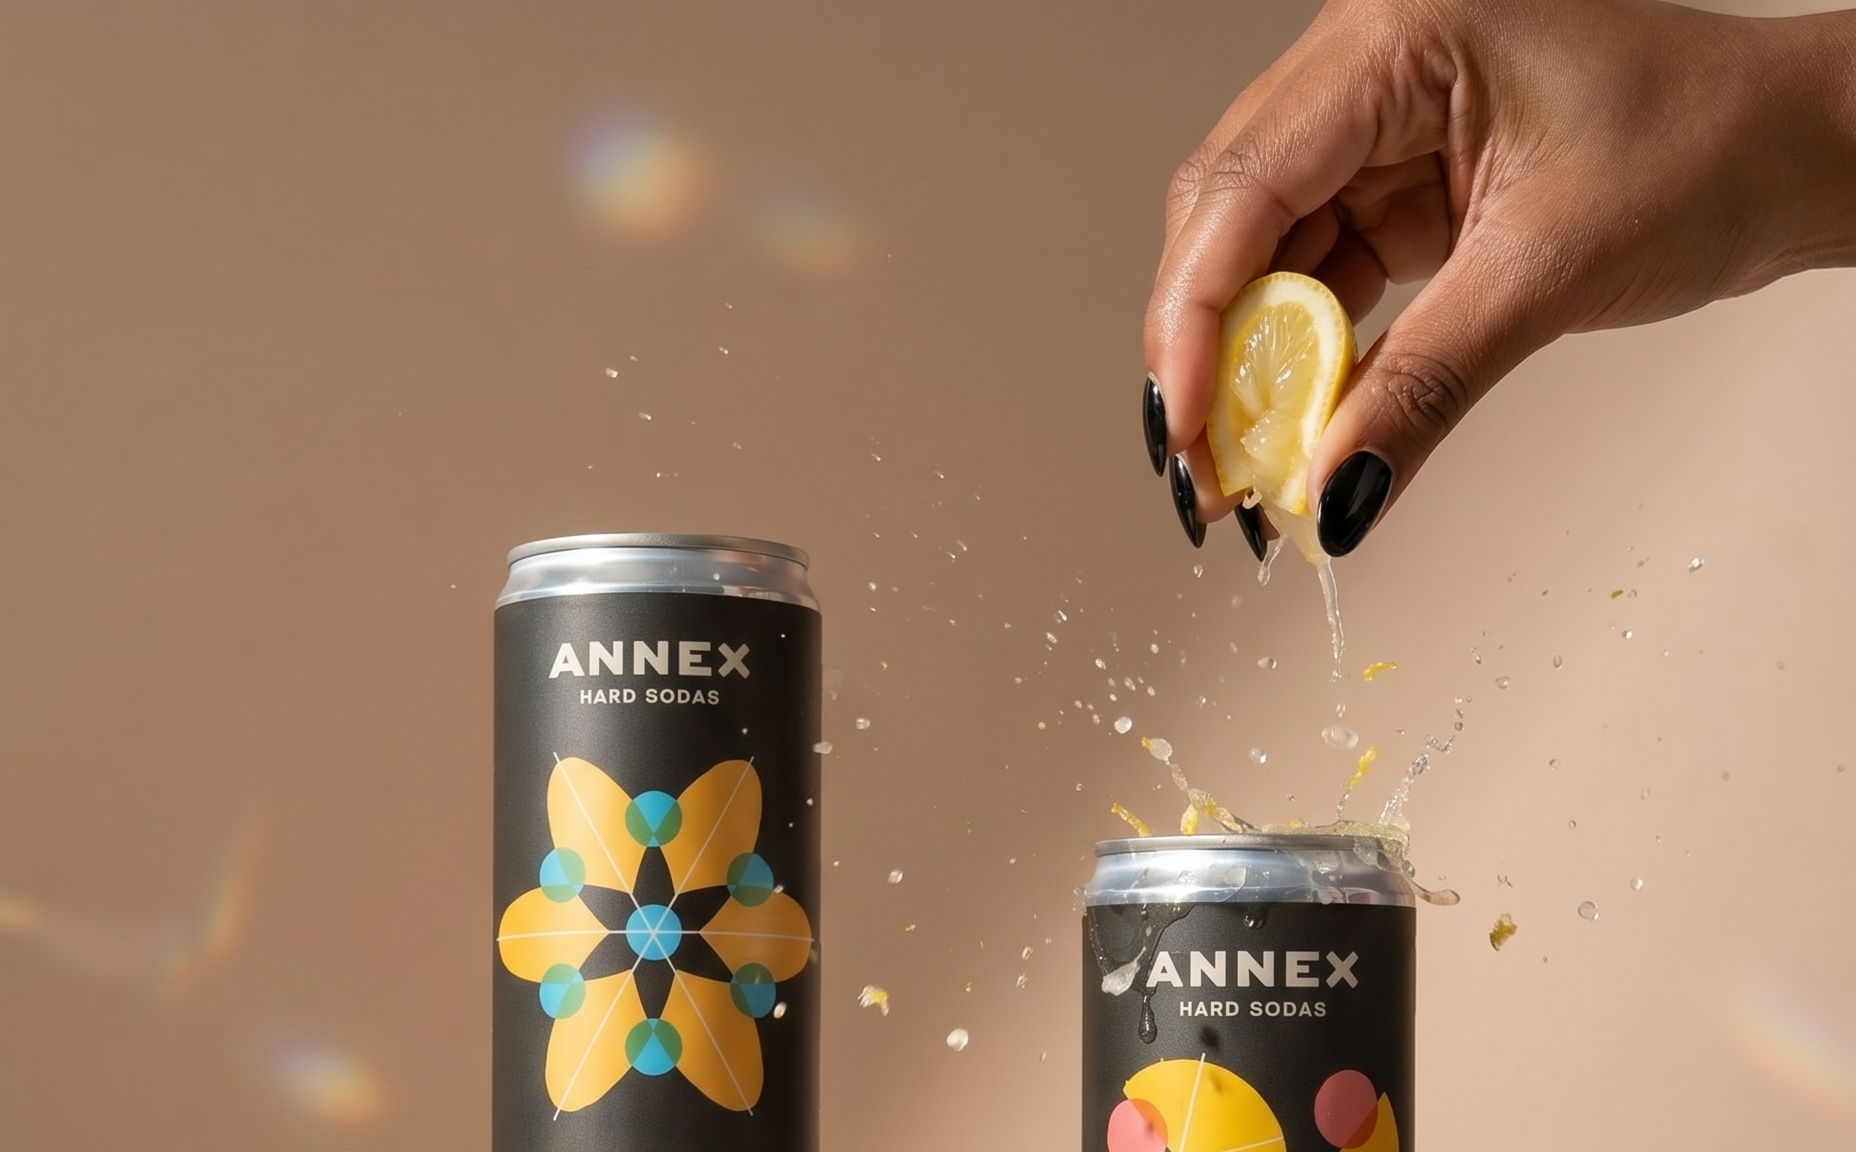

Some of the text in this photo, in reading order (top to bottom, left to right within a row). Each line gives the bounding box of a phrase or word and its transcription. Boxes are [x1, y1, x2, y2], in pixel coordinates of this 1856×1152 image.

[549, 641, 750, 678] ANNEX
[580, 689, 720, 705] HARD SODAS
[1146, 951, 1359, 989] ANNEX
[1179, 1001, 1326, 1017] HARD SODAS
